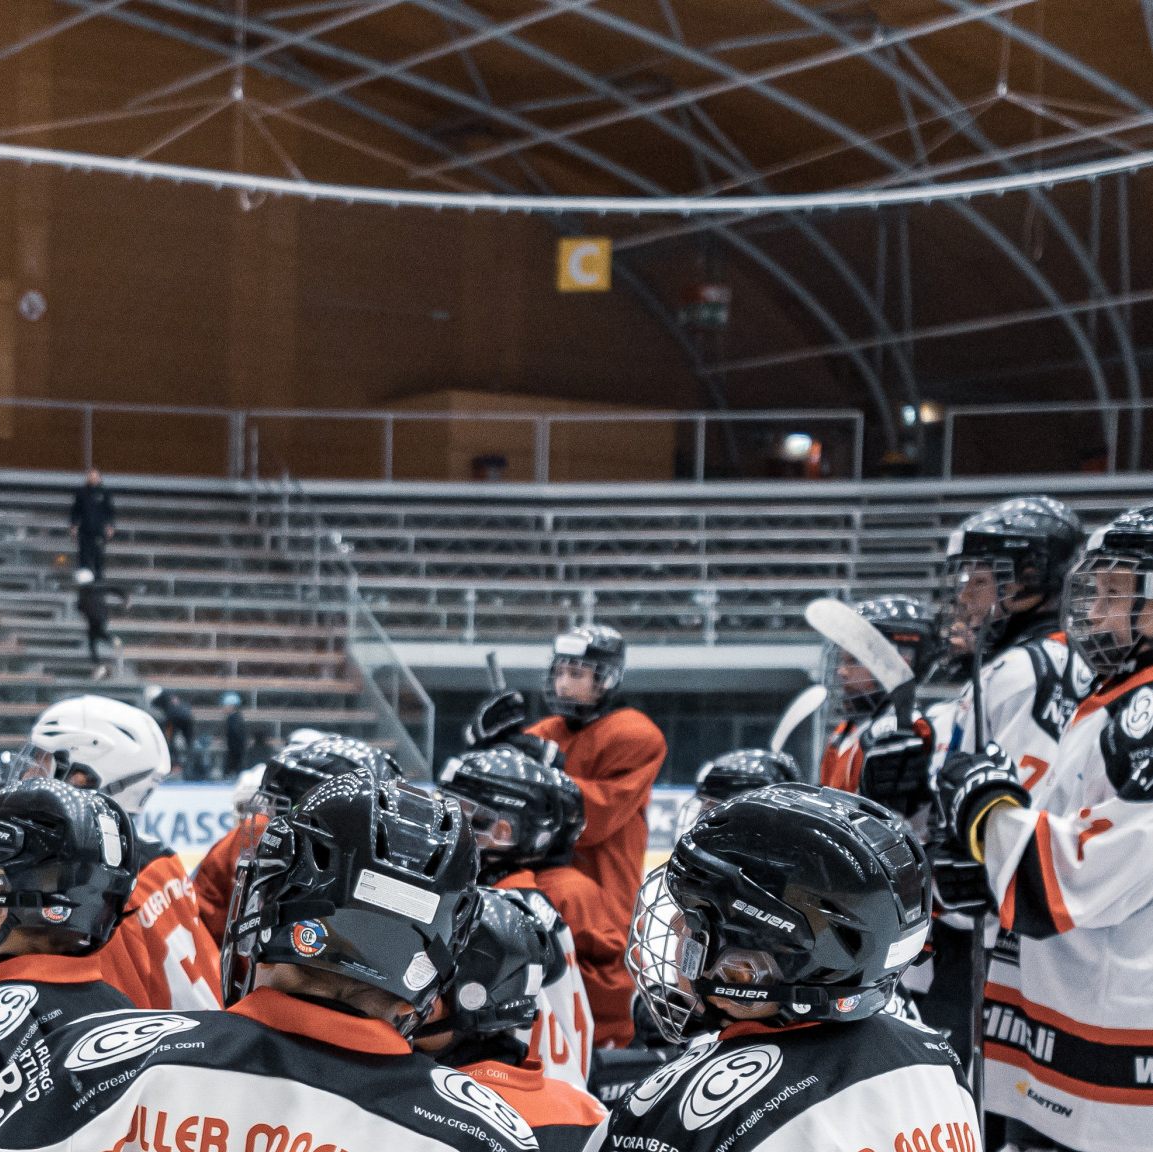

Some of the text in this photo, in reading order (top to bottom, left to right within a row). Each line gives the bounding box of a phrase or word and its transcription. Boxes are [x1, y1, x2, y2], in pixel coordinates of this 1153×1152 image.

[568, 241, 601, 285] C
[731, 899, 797, 934] BAUER
[714, 986, 769, 1000] BAUER
